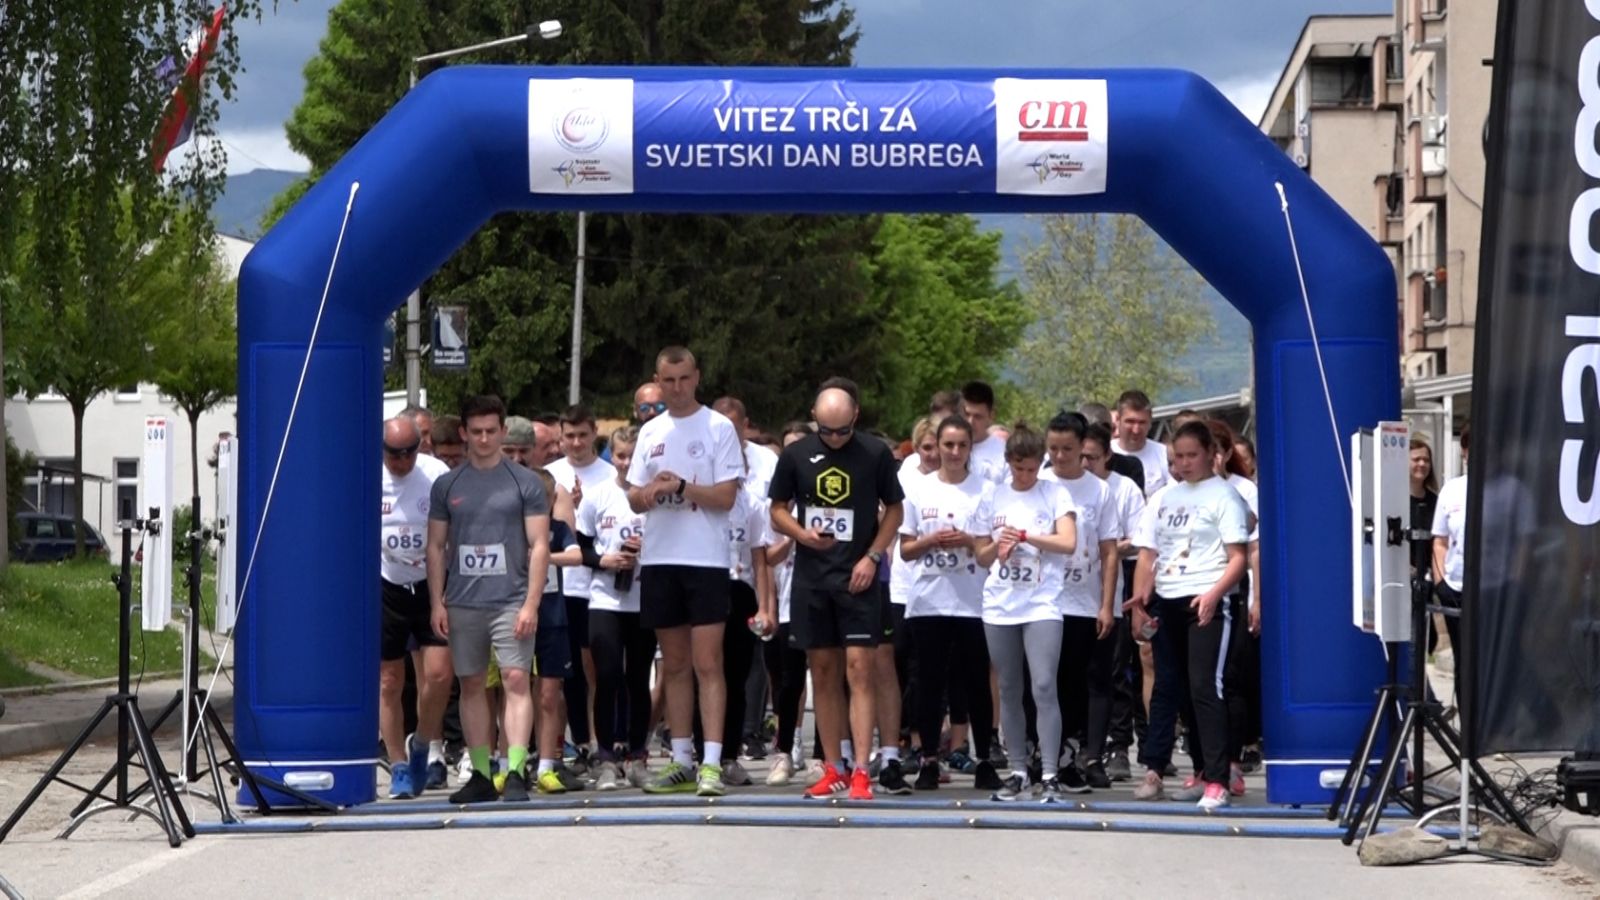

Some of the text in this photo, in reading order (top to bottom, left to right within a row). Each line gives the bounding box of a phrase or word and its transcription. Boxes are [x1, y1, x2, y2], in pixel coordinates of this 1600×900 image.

[714, 101, 918, 132] VITEZ TRČI ZA
[1018, 100, 1088, 129] cm
[646, 143, 984, 168] SVJETSKI DAN BUBREGA
[811, 516, 847, 533] 026
[1167, 514, 1190, 527] 101
[387, 534, 422, 549] 085
[464, 553, 498, 569] 077
[924, 553, 958, 568] 069
[999, 565, 1033, 582] 032
[1063, 567, 1082, 582] 75
